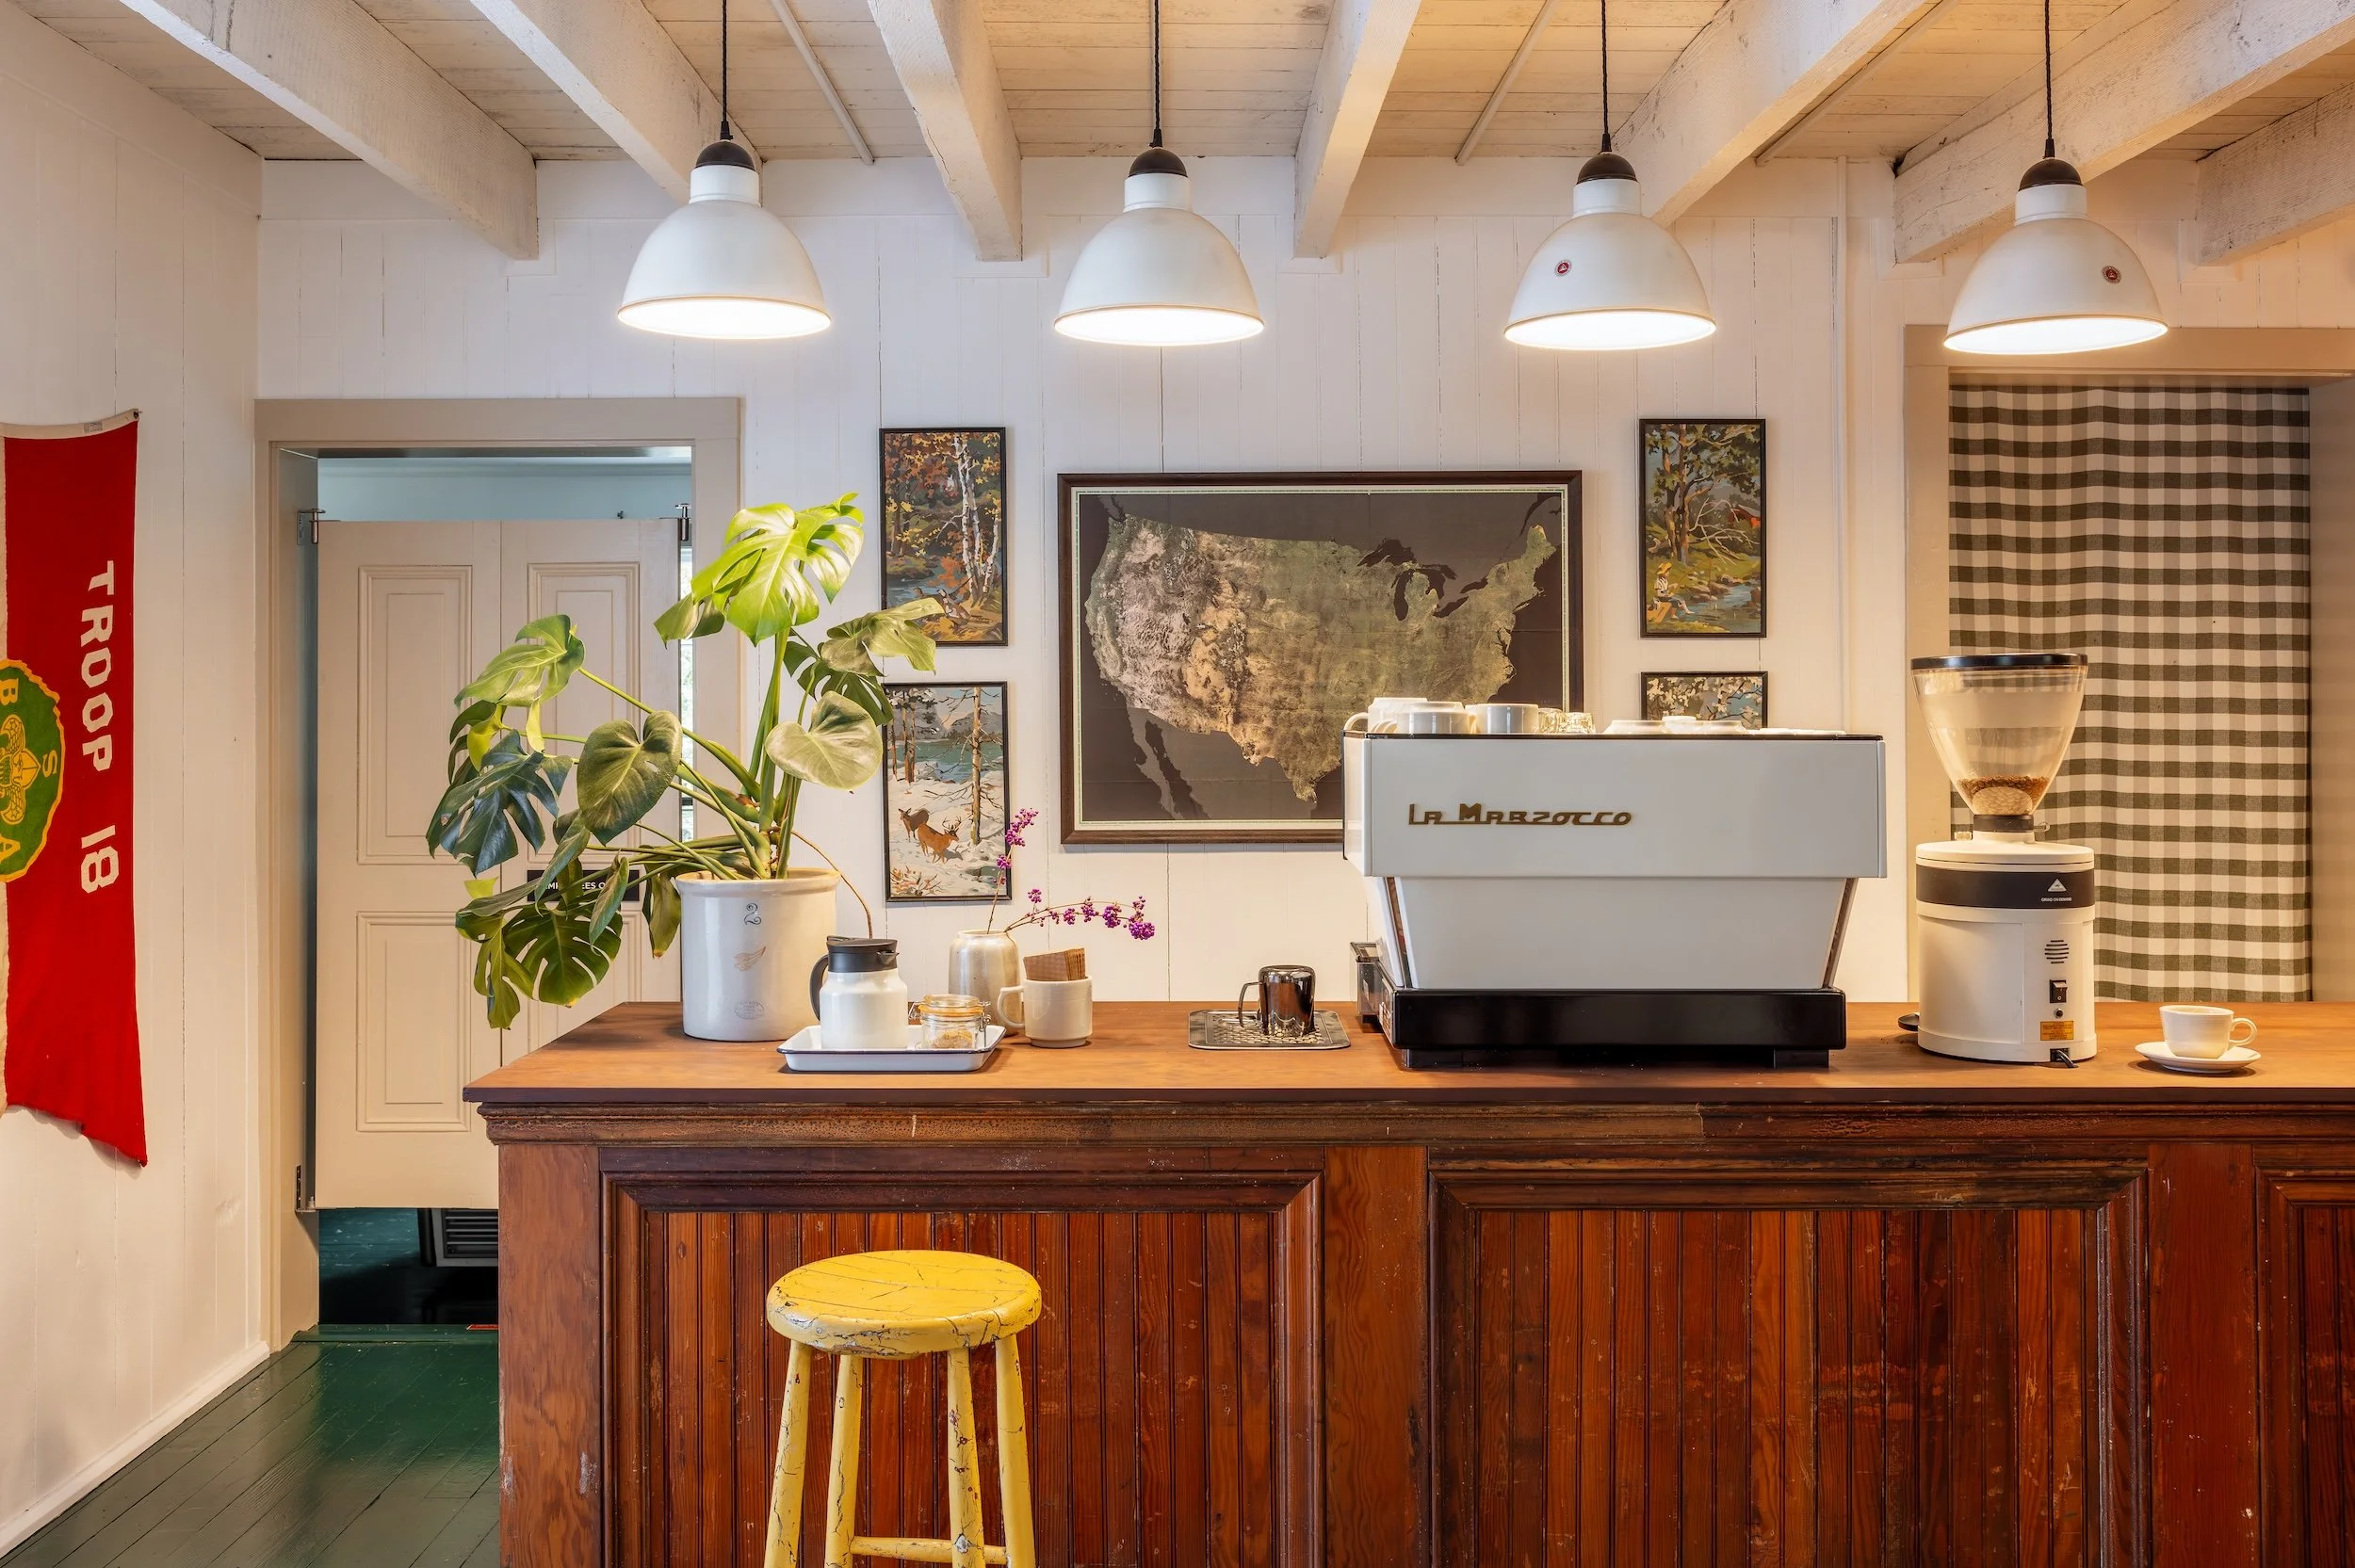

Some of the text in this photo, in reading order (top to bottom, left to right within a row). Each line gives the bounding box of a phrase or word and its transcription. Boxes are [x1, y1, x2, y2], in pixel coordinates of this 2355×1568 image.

[80, 559, 120, 895] TROOP 18
[42, 750, 58, 778] S
[1409, 803, 1632, 826] La Marzocco
[743, 902, 762, 926] 2
